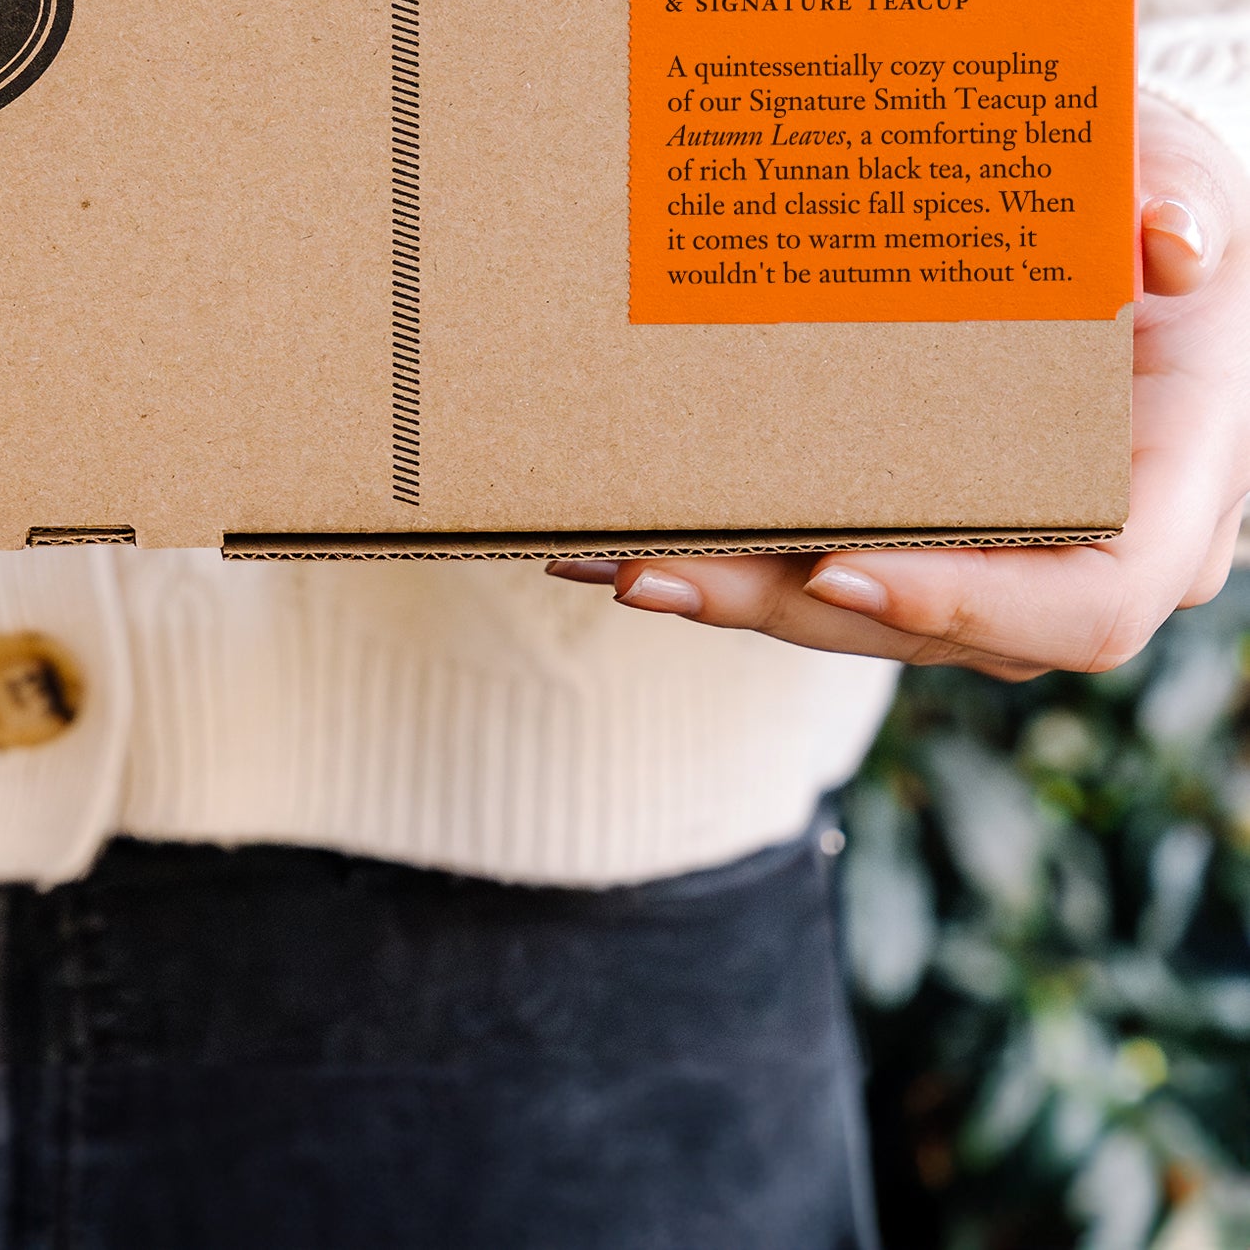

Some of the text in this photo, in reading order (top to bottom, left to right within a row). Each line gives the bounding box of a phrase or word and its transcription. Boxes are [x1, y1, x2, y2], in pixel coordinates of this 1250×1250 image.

[666, 51, 1060, 84] A quintessentially cozy coupling
[667, 85, 1098, 119] of our Signature Smith Teacup and
[665, 119, 1093, 152] Autumn Leaves, a comforting blend
[667, 154, 1052, 184] of rich Yunnan black tea, ancho
[667, 189, 1076, 222] chile and classic fall spices. When
[667, 225, 1038, 253] it comes to warm memories, it
[667, 261, 776, 285] wouldn't
[782, 260, 811, 284] be
[819, 266, 911, 284] autumn
[919, 258, 1015, 283] without
